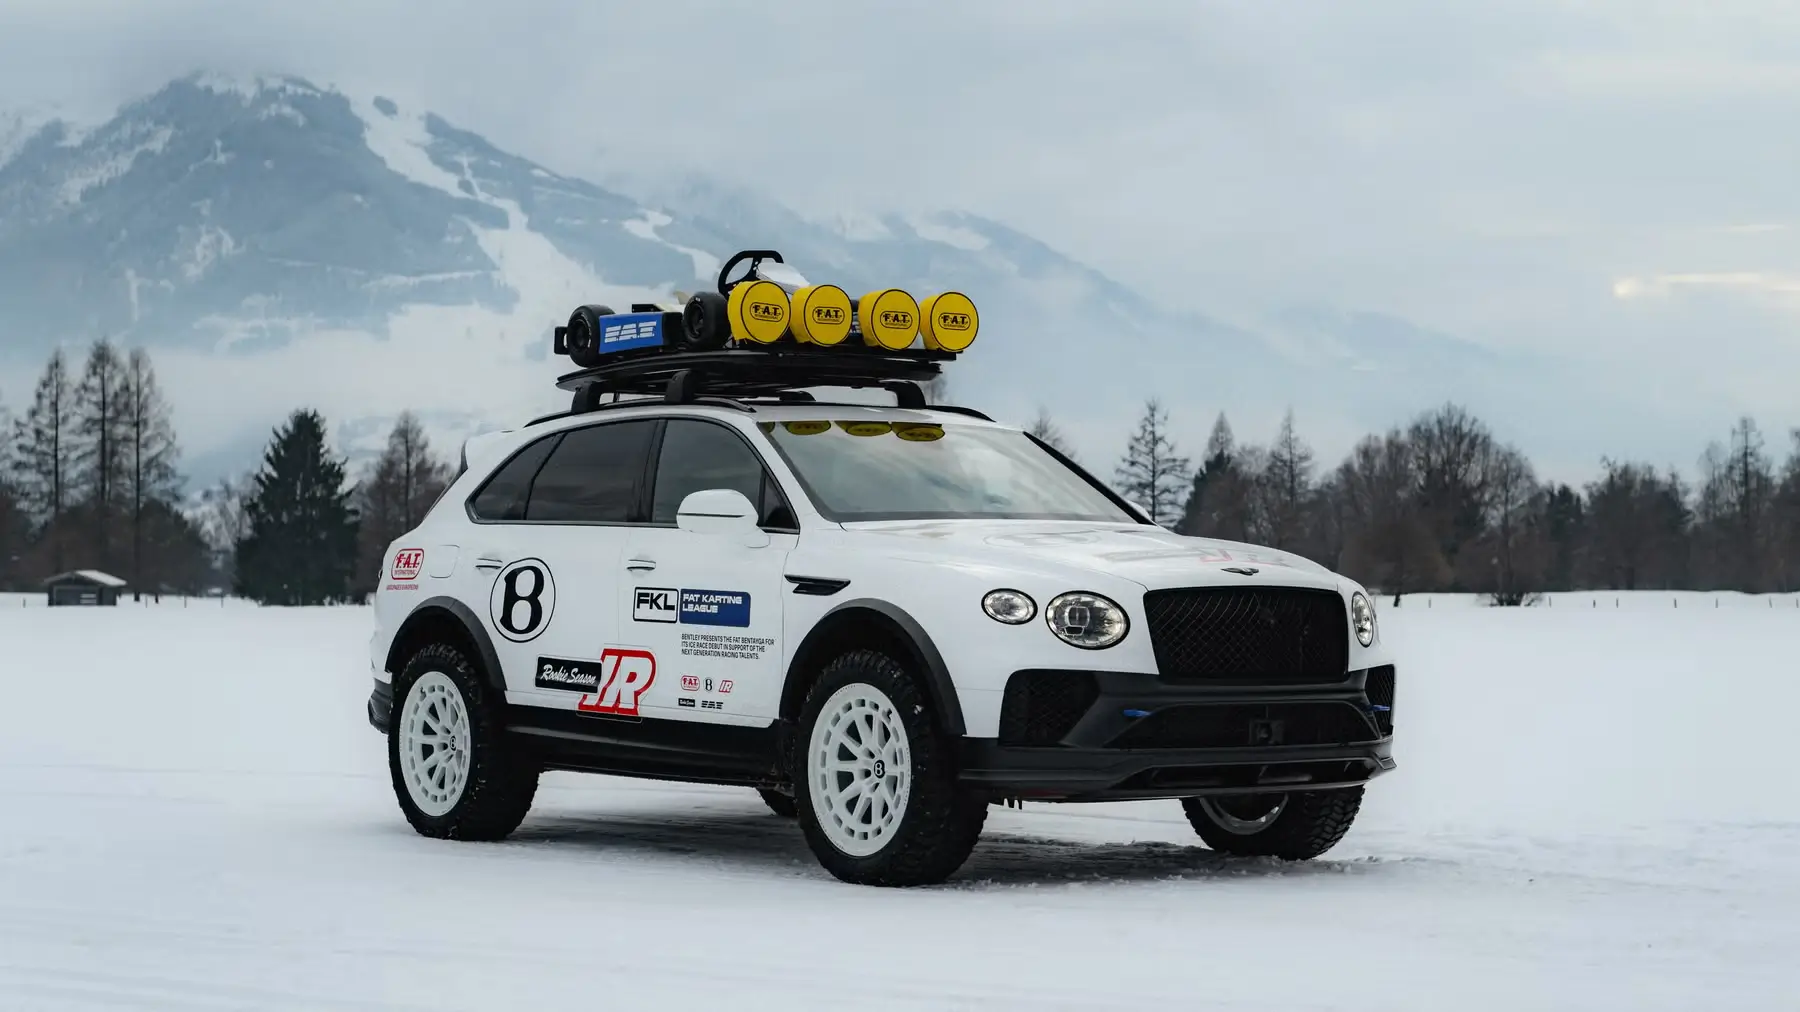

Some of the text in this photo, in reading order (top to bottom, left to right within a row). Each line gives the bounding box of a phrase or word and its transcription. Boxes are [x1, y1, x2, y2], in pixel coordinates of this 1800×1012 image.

[636, 592, 675, 611] FKL
[682, 593, 742, 605] FAT KARTING
[682, 604, 718, 613] LEAGUE
[681, 633, 700, 641] BENTLEY
[700, 634, 723, 643] PRESENTS
[732, 636, 741, 644] FAT
[741, 637, 765, 645] BENTAYGA
[765, 638, 775, 646] FOR
[696, 641, 708, 649] RACE
[708, 642, 723, 650] DEBUT
[728, 643, 749, 652] SUPPORT
[756, 645, 765, 653] THE
[681, 648, 693, 656] NEXT
[693, 649, 720, 657] GENERATION
[721, 651, 738, 659] RACING
[540, 663, 597, 685] Rookie Season
